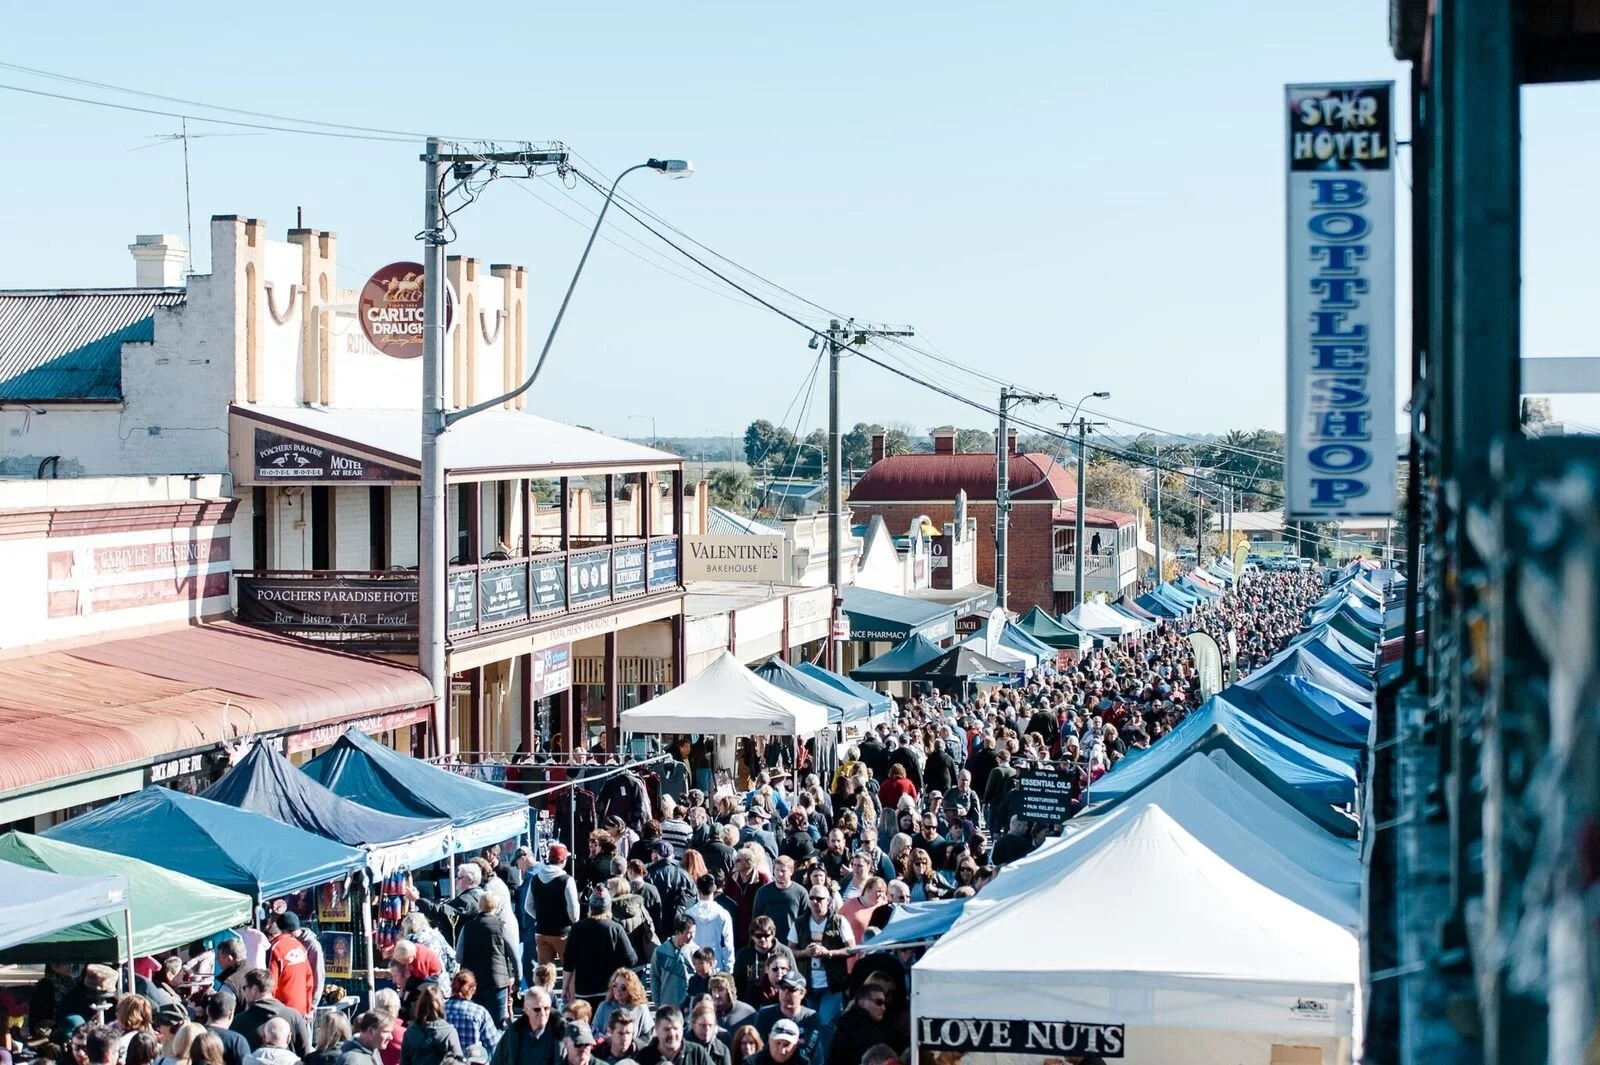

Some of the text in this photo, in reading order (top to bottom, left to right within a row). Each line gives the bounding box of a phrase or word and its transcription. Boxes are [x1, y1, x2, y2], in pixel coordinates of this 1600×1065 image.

[367, 307, 424, 322] CARLTO
[260, 444, 324, 458] POACHERS PARADISE
[331, 455, 363, 470] MOTEL
[154, 543, 209, 563] PRESENCE
[706, 564, 758, 573] BAKEHOUSE
[257, 590, 418, 603] POACHERS PARADISE HOTE
[274, 612, 408, 625] Bar Bistro TAB Foxtel
[867, 630, 907, 639] PHARMACY
[1021, 778, 1071, 790] ESSENTIAL OILS
[920, 1018, 1123, 1054] LOVE NUTS
